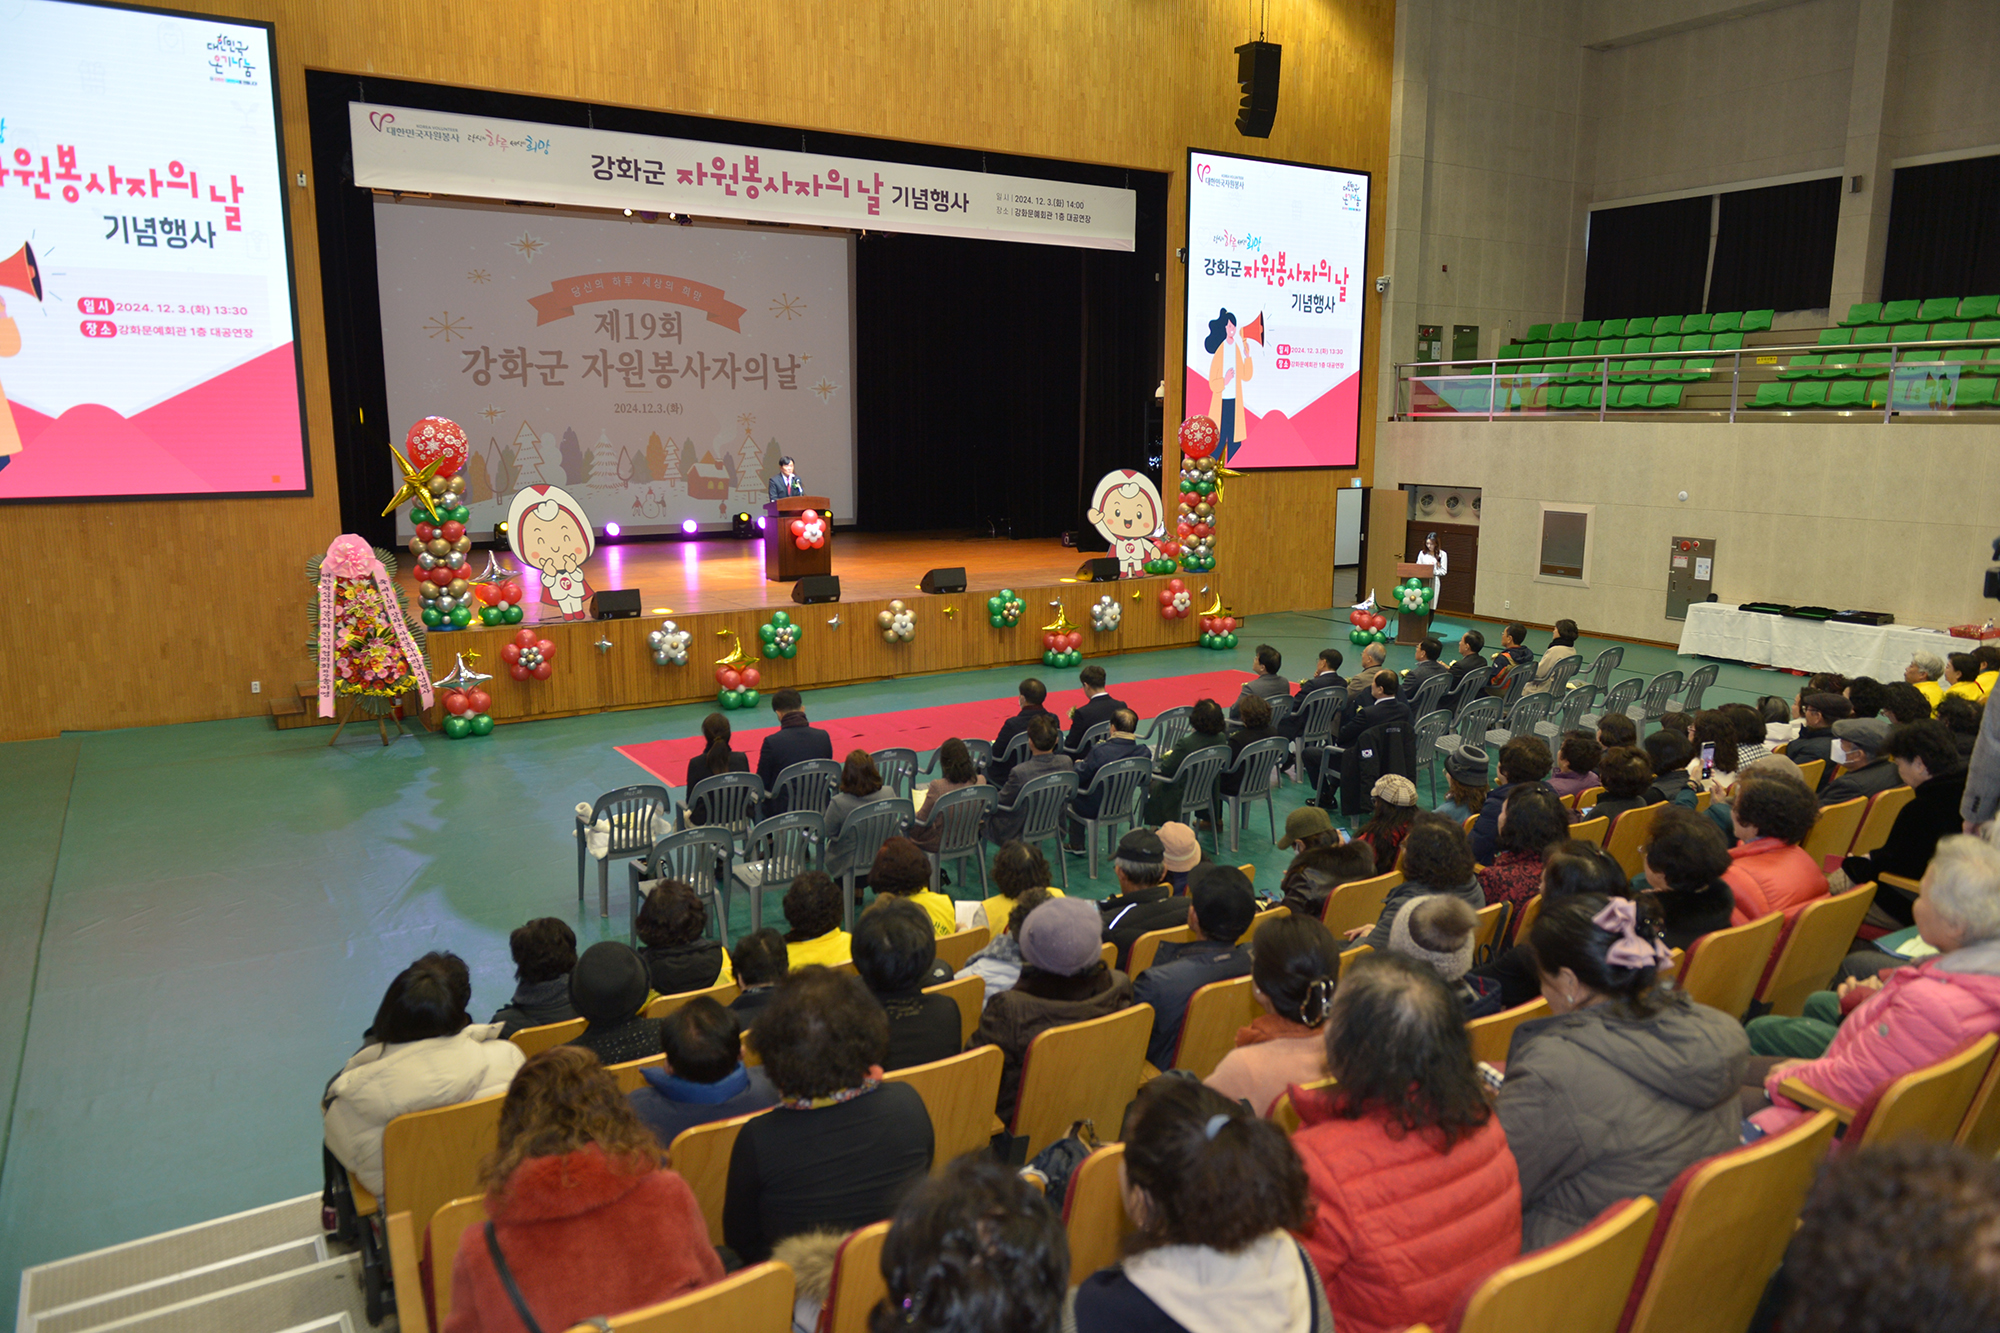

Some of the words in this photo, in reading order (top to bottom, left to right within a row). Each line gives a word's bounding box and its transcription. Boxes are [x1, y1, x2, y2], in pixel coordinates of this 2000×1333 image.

[386, 126, 460, 143] 대한민국자원봉사
[525, 134, 551, 155] 희망
[591, 154, 666, 185] 강화군
[676, 155, 849, 200] 자원봉사자의
[857, 173, 884, 216] 날
[891, 185, 970, 214] 기념행사
[209, 175, 244, 231] 날
[996, 193, 1009, 201] 일시
[1015, 195, 1034, 204] 2024.
[1036, 196, 1046, 205] 12.
[1066, 201, 1084, 209] 14:00
[996, 206, 1009, 215] 장소
[1015, 208, 1053, 220] 강화문예회관
[1055, 212, 1065, 222] 1층
[1066, 214, 1091, 224] 대공연장
[103, 215, 216, 249] 기념행사
[1204, 258, 1242, 277] 강화군
[1244, 251, 1331, 287] 자원봉사자의
[1335, 267, 1349, 302] 날
[570, 278, 604, 299] 당신의
[612, 275, 633, 288] 하루
[641, 276, 674, 292] 세상의
[682, 284, 703, 302] 희망
[83, 299, 110, 314] 일시
[116, 302, 154, 313] 2024.
[157, 303, 175, 314] 12.
[178, 304, 210, 316] 3.(화)
[214, 306, 248, 316] 13:30
[1291, 294, 1336, 314] 기념행사
[86, 322, 112, 336] 장소
[118, 324, 188, 337] 강화문예회관
[190, 326, 207, 337] 1층
[210, 328, 254, 339] 대공연장
[594, 308, 683, 345] 제19회
[461, 345, 569, 388] 강화군
[581, 348, 801, 391] 자원봉사자의날
[613, 402, 684, 416] 2024.12.3.(화)
